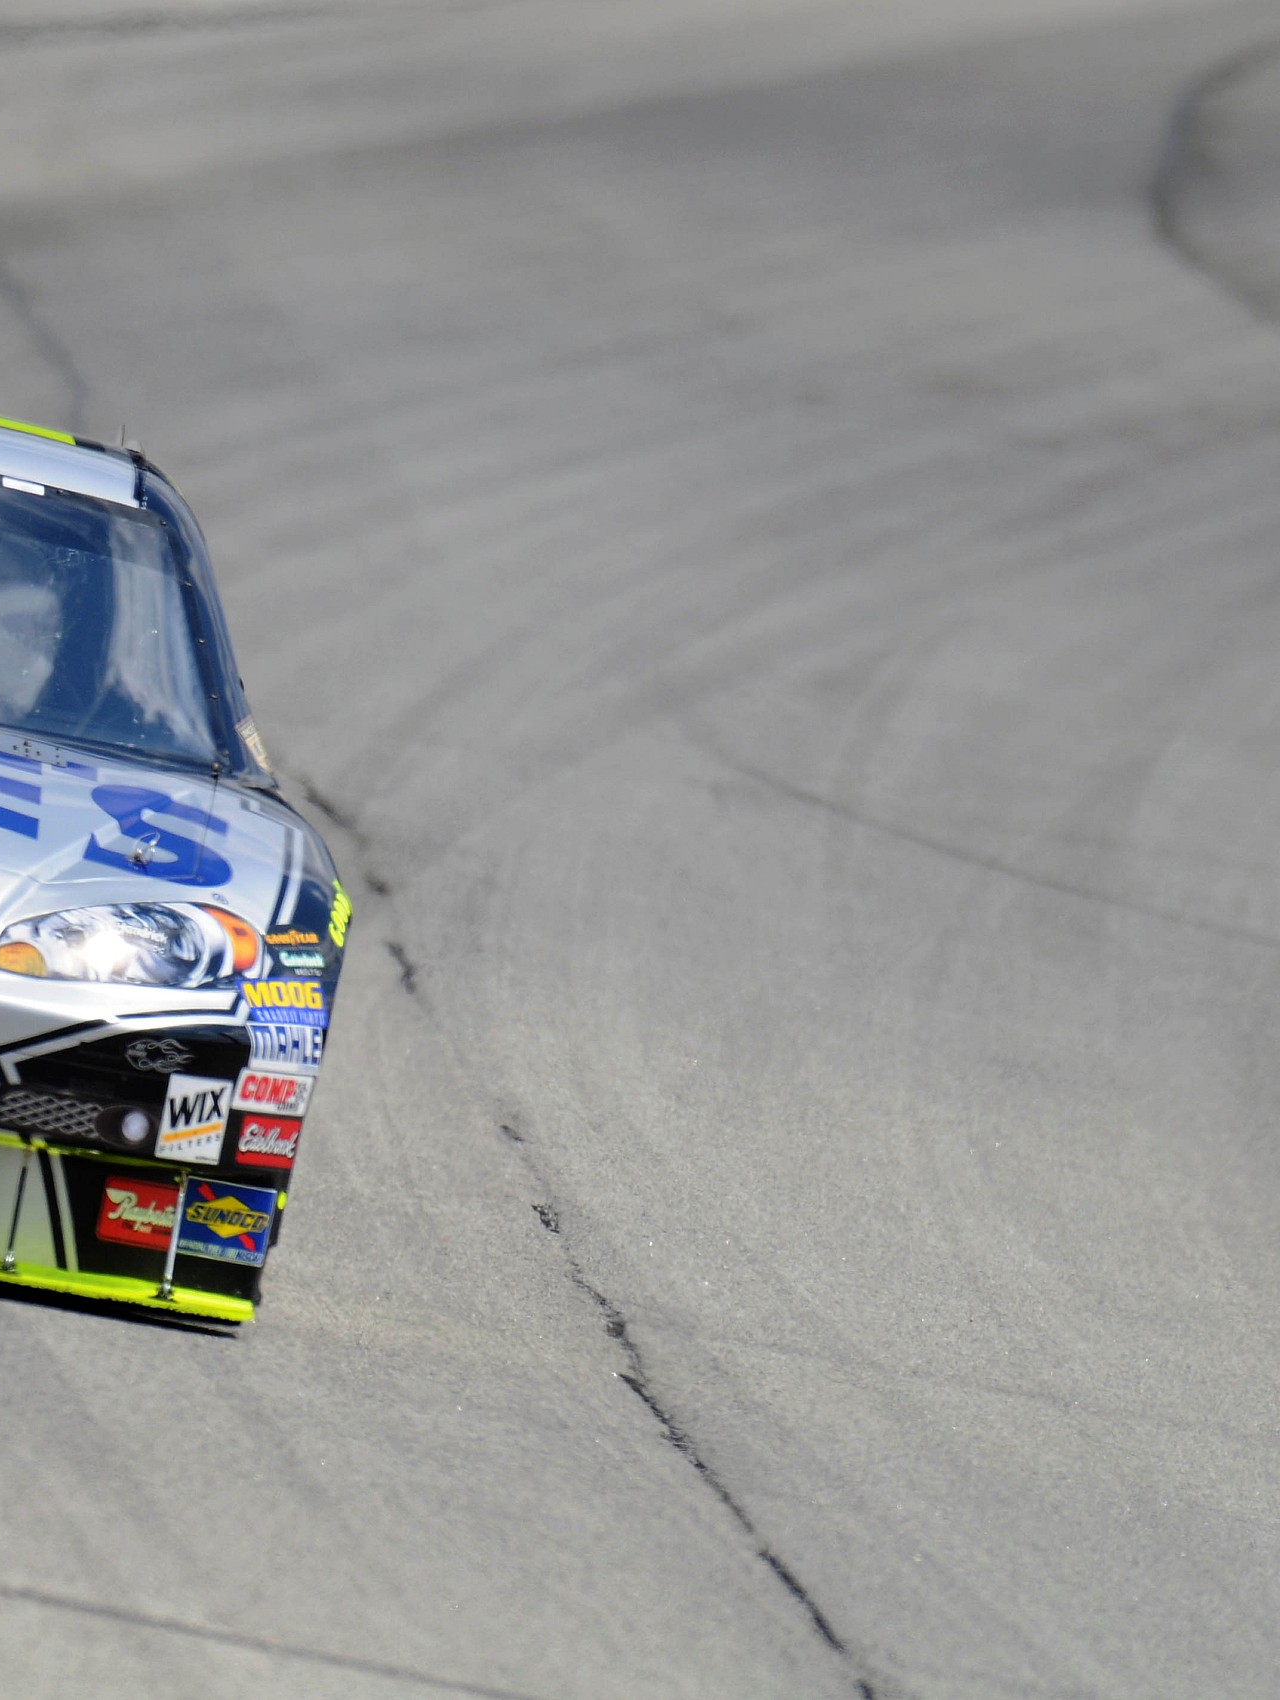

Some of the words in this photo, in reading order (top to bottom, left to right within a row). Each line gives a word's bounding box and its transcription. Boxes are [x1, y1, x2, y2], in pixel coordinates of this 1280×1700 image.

[242, 981, 324, 1010] MOOG
[240, 1074, 297, 1105] COMP
[169, 1086, 226, 1129] WIX
[158, 1133, 222, 1153] FILTERS
[188, 1205, 269, 1233] SUNOCO
